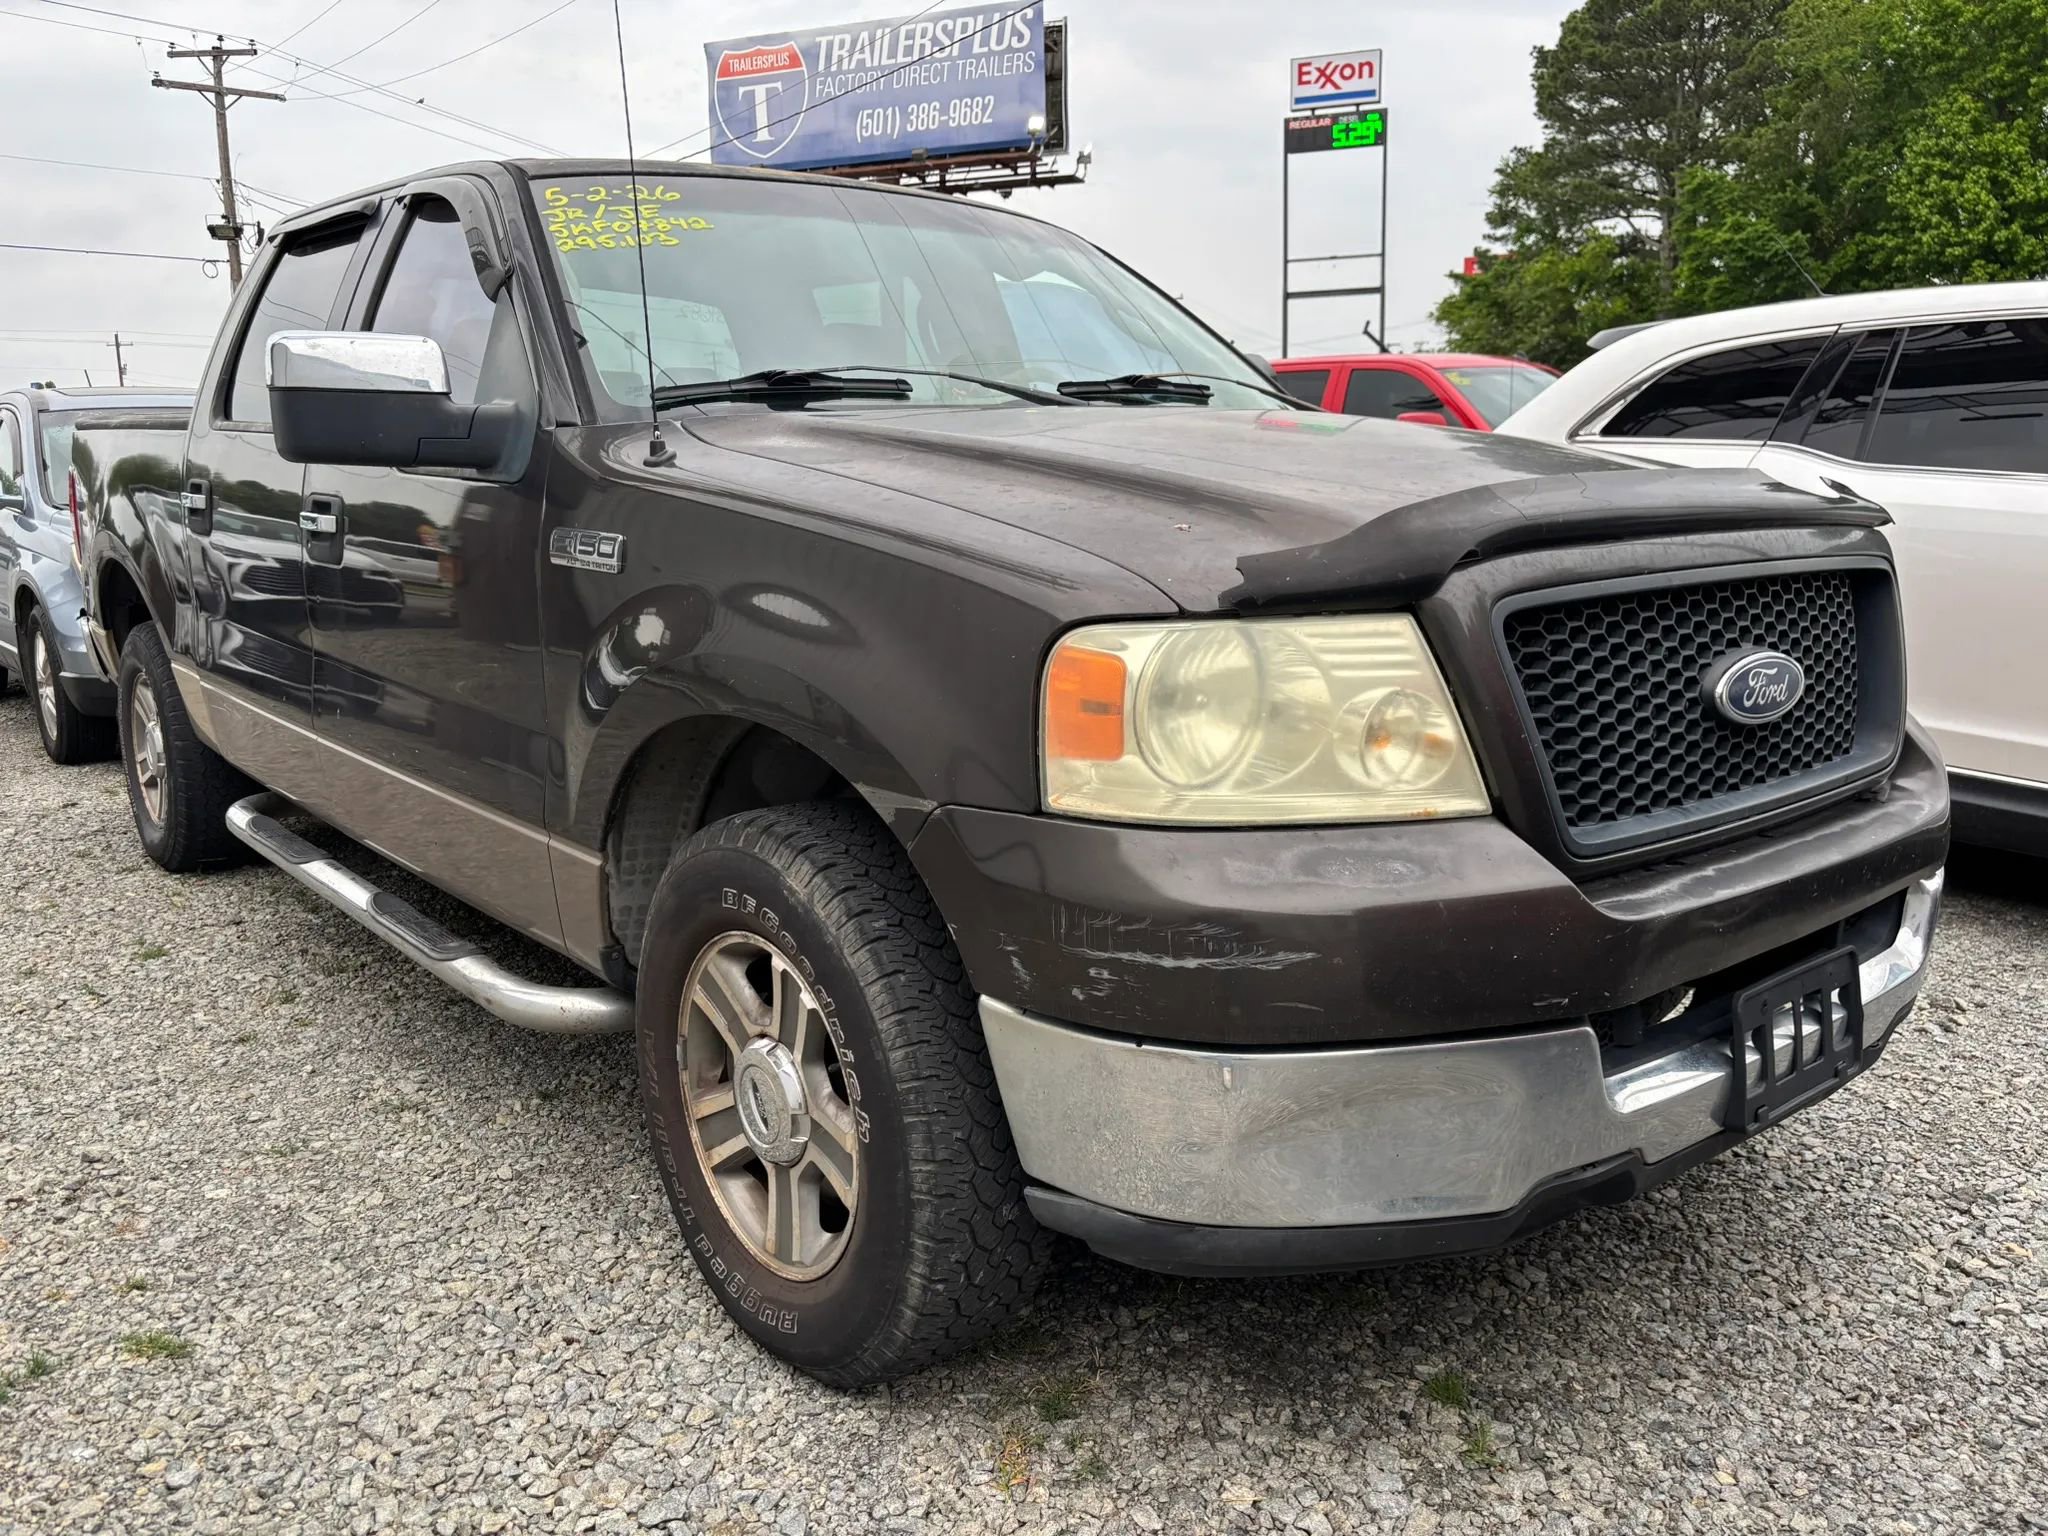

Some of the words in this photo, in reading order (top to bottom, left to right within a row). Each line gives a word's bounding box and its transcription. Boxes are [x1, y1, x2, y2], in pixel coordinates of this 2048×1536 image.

[729, 52, 790, 73] TRAILERSPLUS
[815, 8, 1034, 73] TRAILERSPLUS
[815, 69, 890, 98] FACTORY
[893, 61, 952, 89] DIRECT
[956, 51, 1036, 80] TRAILERS
[1297, 61, 1375, 90] Exxon
[738, 80, 784, 143] T
[856, 105, 900, 141] (501)
[907, 95, 995, 133] 386-9682
[1289, 117, 1333, 130] REGULAR
[545, 184, 682, 206] 5-2-26
[1743, 666, 1789, 708] Ford
[694, 1233, 799, 1335] Rugged
